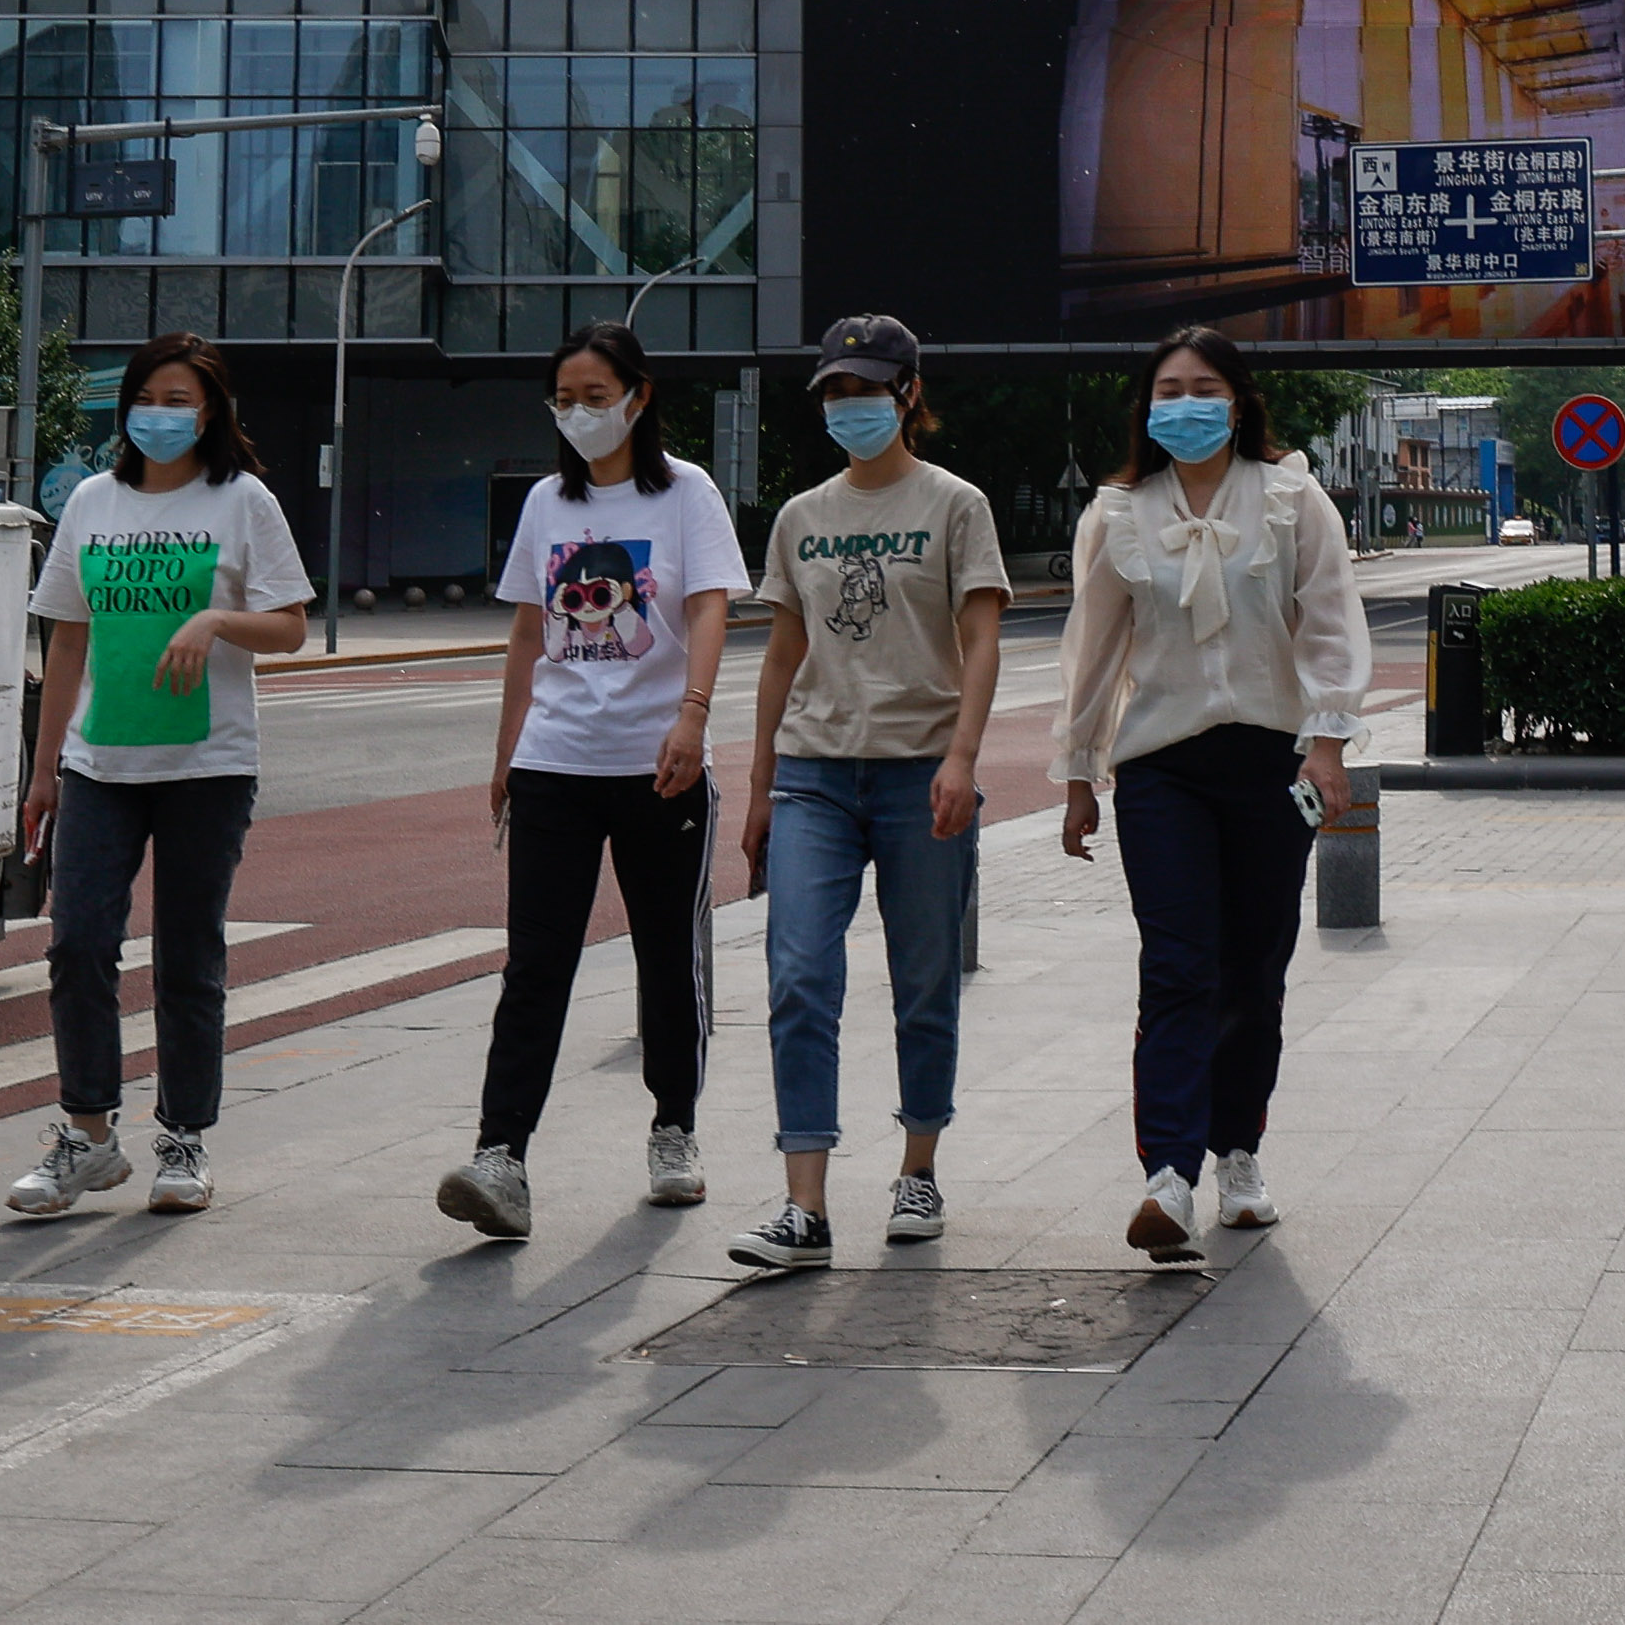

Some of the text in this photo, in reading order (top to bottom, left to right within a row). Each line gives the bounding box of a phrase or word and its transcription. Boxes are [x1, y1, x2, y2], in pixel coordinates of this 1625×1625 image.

[1361, 156, 1392, 174] 西 W
[1435, 173, 1487, 187] JINGHUA
[1492, 173, 1505, 186] St
[1516, 172, 1545, 185] JINTONG
[1358, 192, 1451, 216] 金桐东路
[1489, 188, 1584, 212] 金桐东路
[1358, 215, 1439, 230] JINTONG East Rd
[1503, 211, 1586, 226] JINTONG East Rd
[1425, 252, 1518, 272] 景华街中口
[798, 530, 931, 562] CAMPOUT
[102, 557, 185, 583] DOPO
[87, 585, 192, 614] GIORNO
[1448, 602, 1472, 618] 入口
